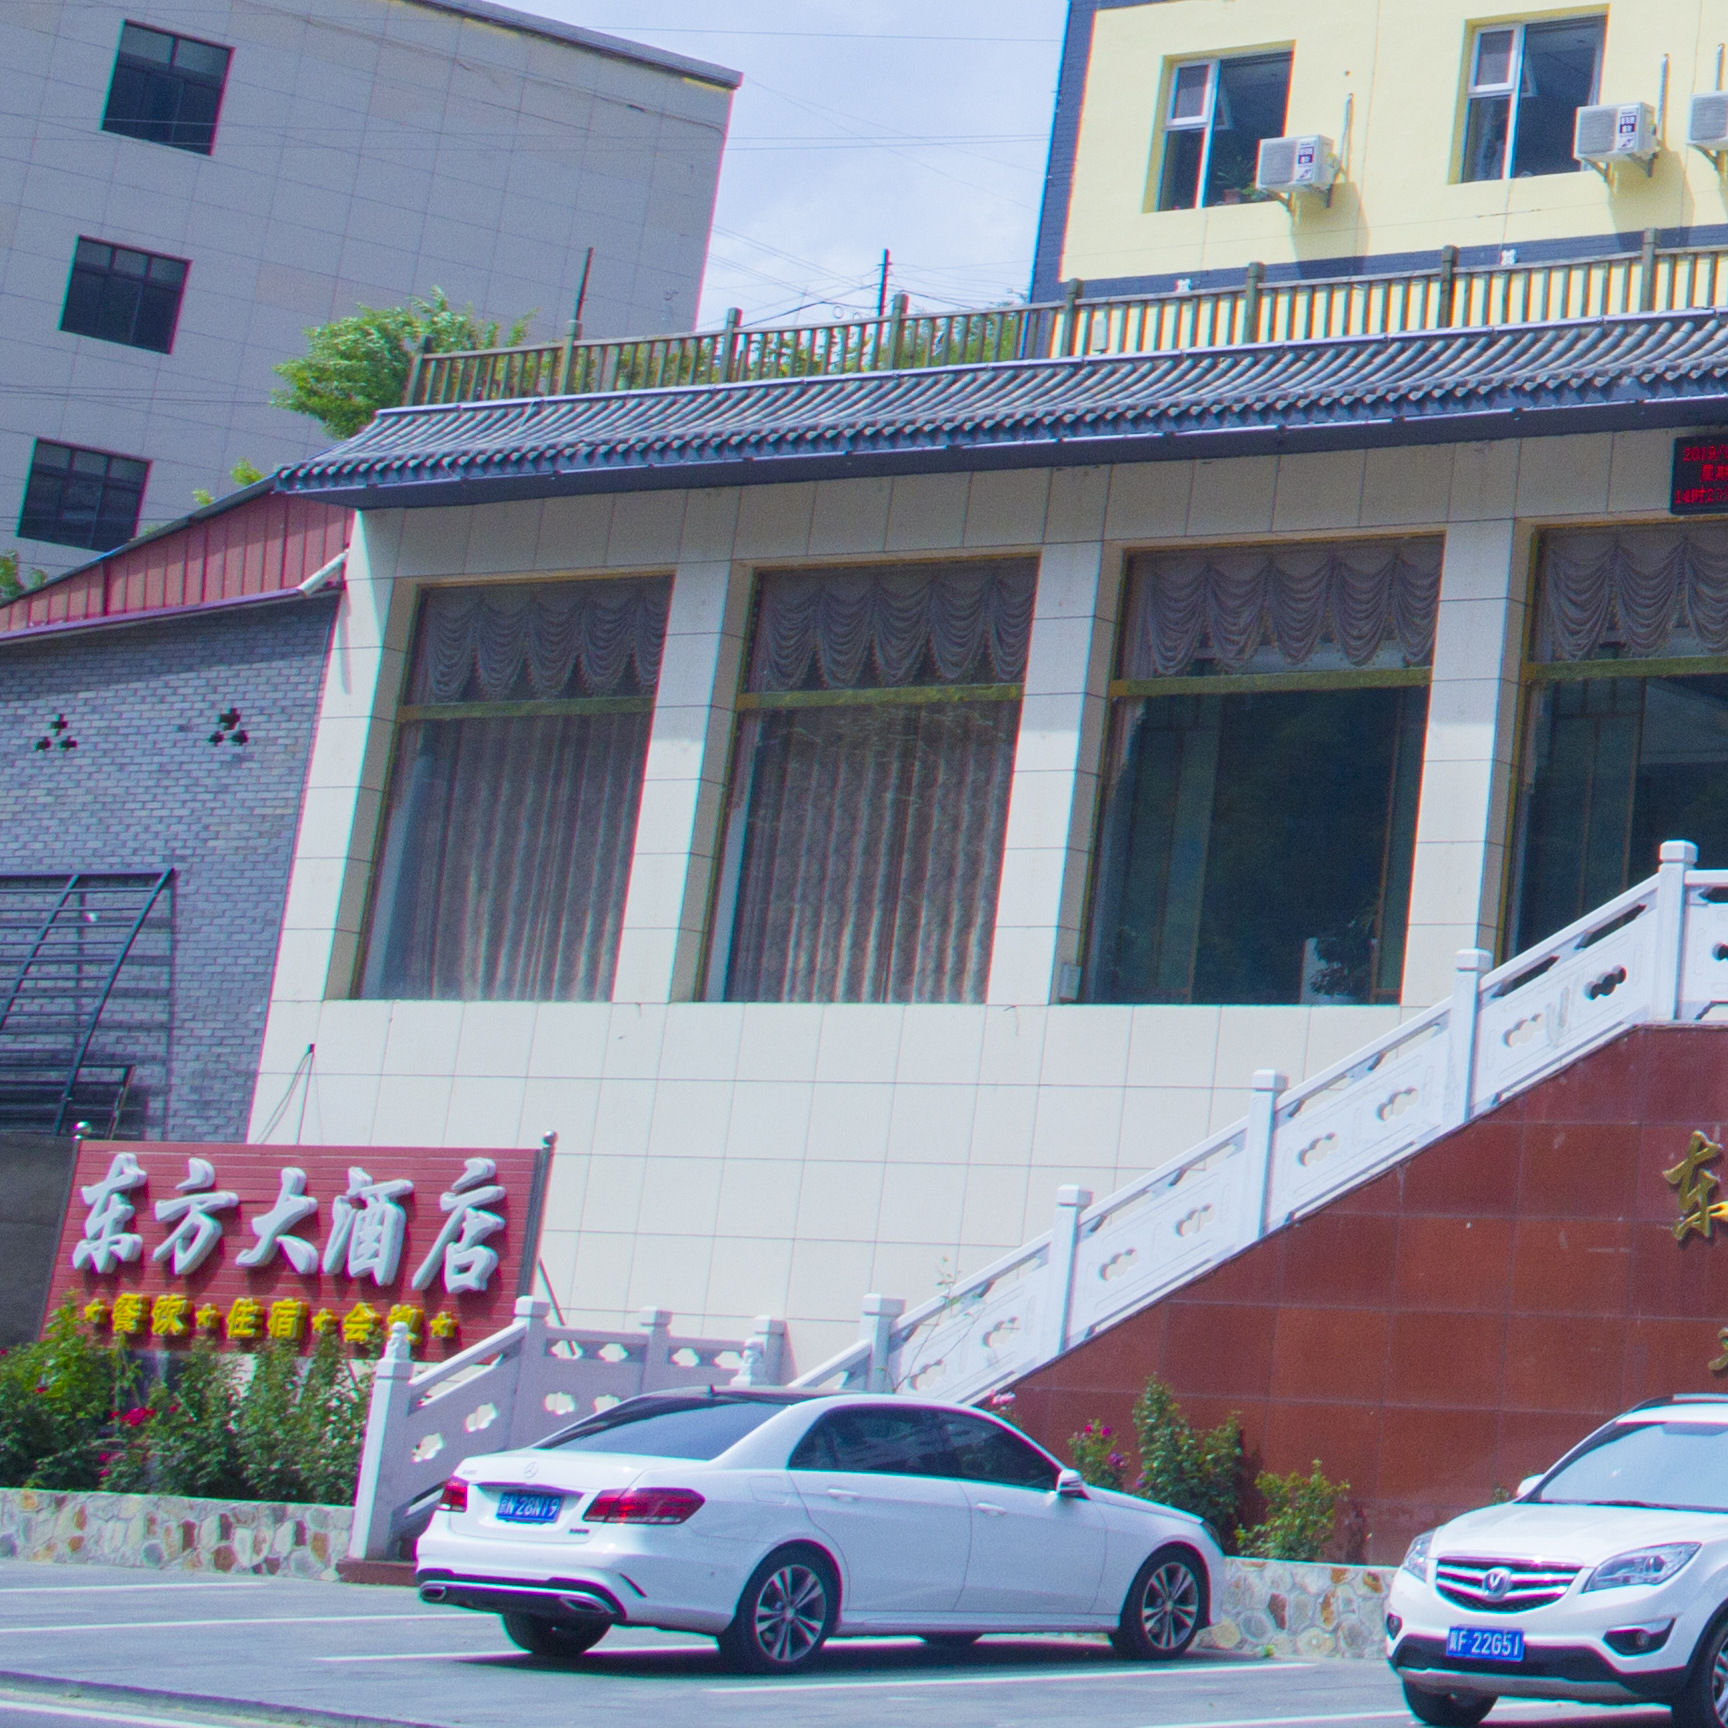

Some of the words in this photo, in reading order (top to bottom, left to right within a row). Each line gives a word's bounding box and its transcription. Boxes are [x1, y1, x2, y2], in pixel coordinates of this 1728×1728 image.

[73, 1152, 507, 1294] 东方大酒店
[112, 1292, 193, 1336] 餐饮
[226, 1297, 310, 1340] 住宿
